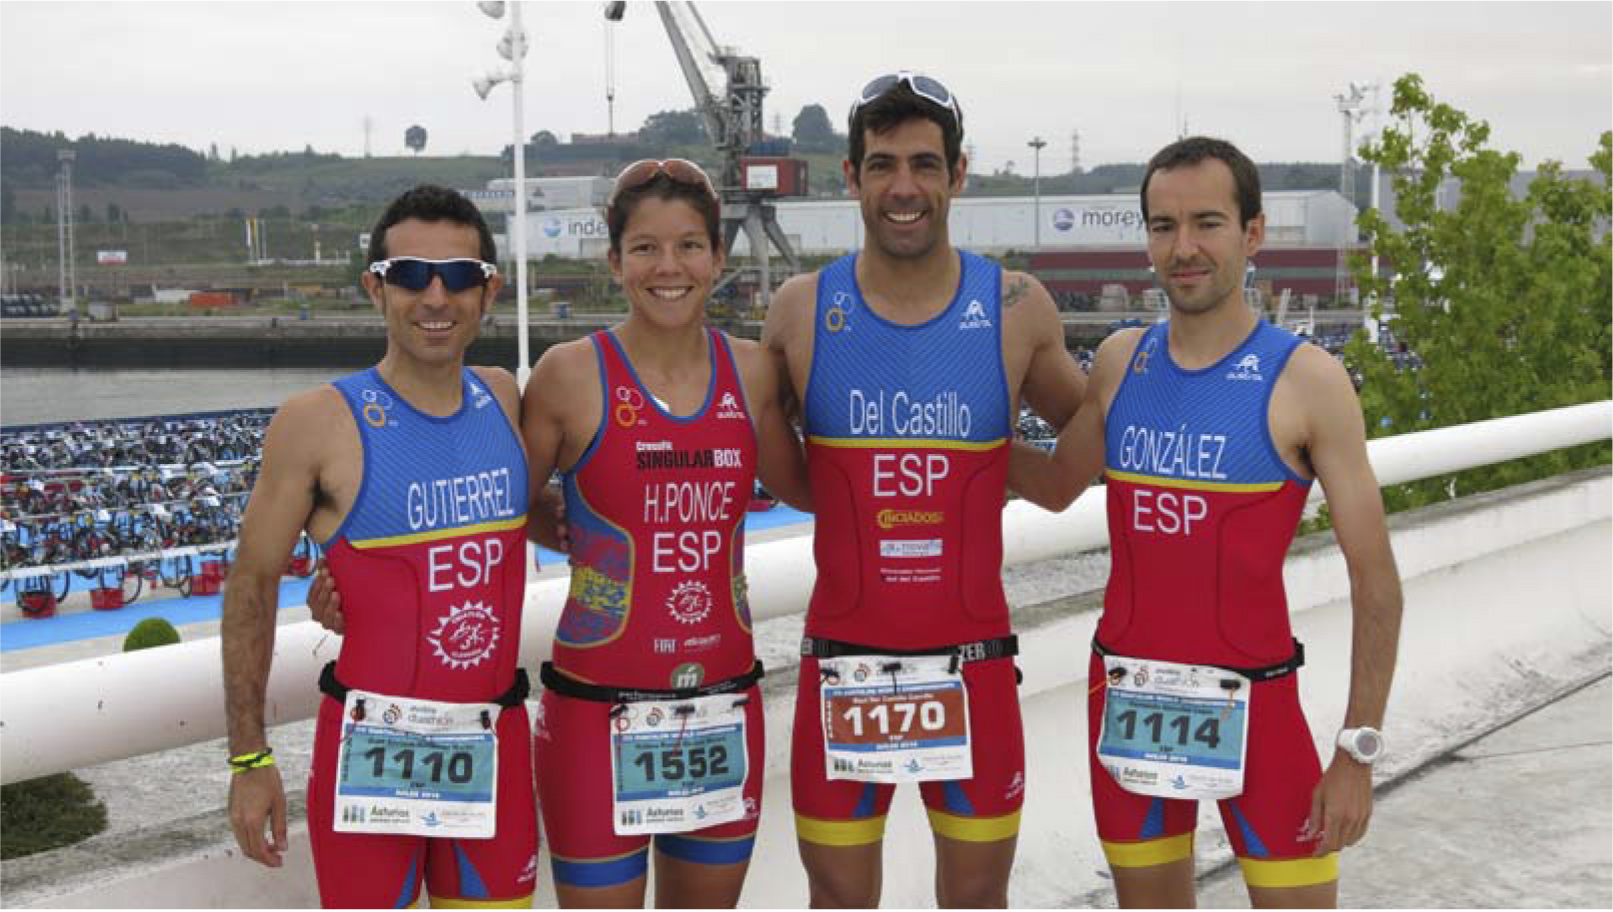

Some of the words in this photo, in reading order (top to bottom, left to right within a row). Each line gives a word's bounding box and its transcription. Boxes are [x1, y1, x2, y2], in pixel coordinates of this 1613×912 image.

[850, 389, 884, 436] Del
[892, 390, 972, 439] Castillo
[1119, 423, 1228, 480] GONZÁLEZ
[873, 453, 950, 497] ESP
[407, 466, 515, 531] GUTIERREZ
[643, 480, 736, 524] H.PONCE
[1133, 489, 1208, 536] ESP
[428, 538, 504, 593] ESP
[653, 530, 722, 573] ESP
[843, 700, 946, 736] 1170
[1116, 710, 1220, 749] 1114
[364, 747, 473, 784] 1110
[634, 744, 730, 782] 1552
